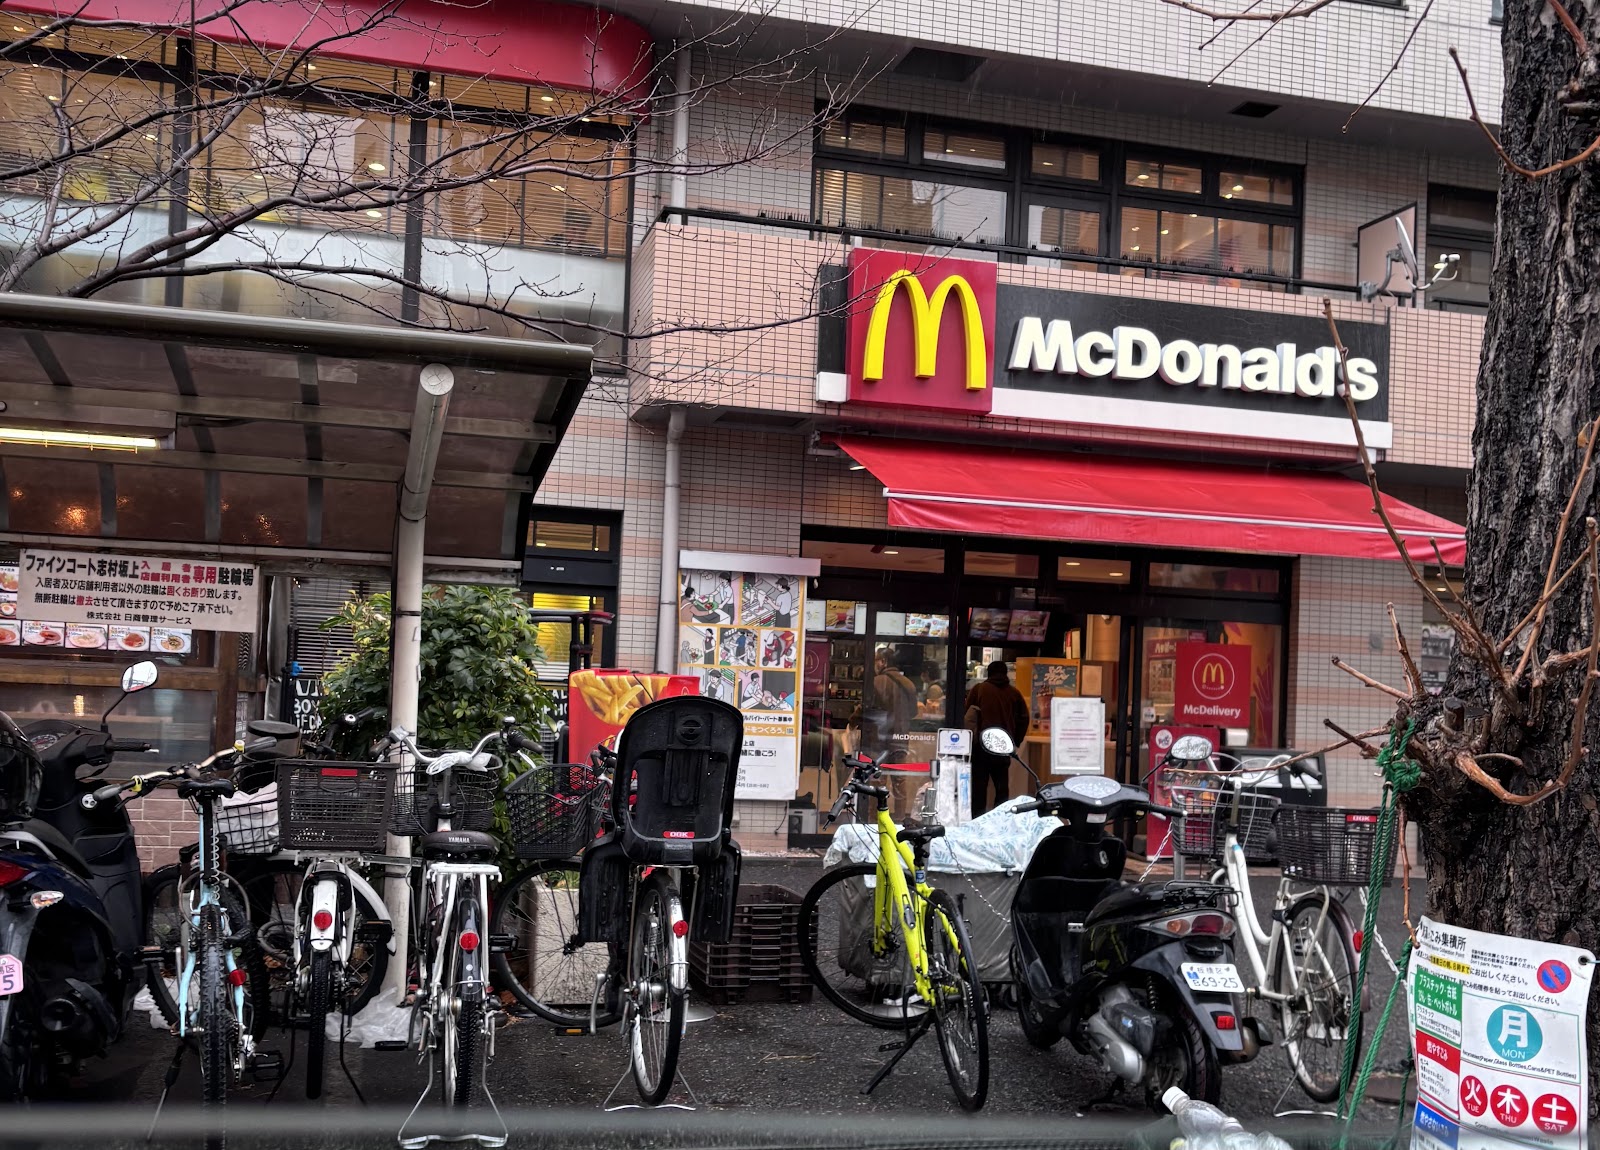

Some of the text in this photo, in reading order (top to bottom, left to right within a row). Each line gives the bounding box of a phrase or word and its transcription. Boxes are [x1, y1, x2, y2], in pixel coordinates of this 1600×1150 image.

[1008, 316, 1379, 401] McDonald's
[25, 554, 139, 579] ファインコート志村坂上
[35, 577, 242, 601] 入居者及び店舗利用者以外の駐輪は固くお断り致します。
[34, 593, 234, 615] 無断駐輪は撤去させて頂きますので予めご了承下さい。
[87, 611, 121, 621] 株式会社
[741, 715, 793, 723] ルバイト・パート募集中
[1183, 704, 1241, 719] McDelivery
[1497, 1009, 1529, 1048] 月
[1501, 1049, 1526, 1060] MON
[1464, 1079, 1482, 1106] 火
[1496, 1087, 1521, 1115] 木
[1539, 1097, 1568, 1125] 土
[1466, 1102, 1480, 1113] TUE
[1499, 1112, 1517, 1124] THU
[1544, 1123, 1564, 1132] SAT
